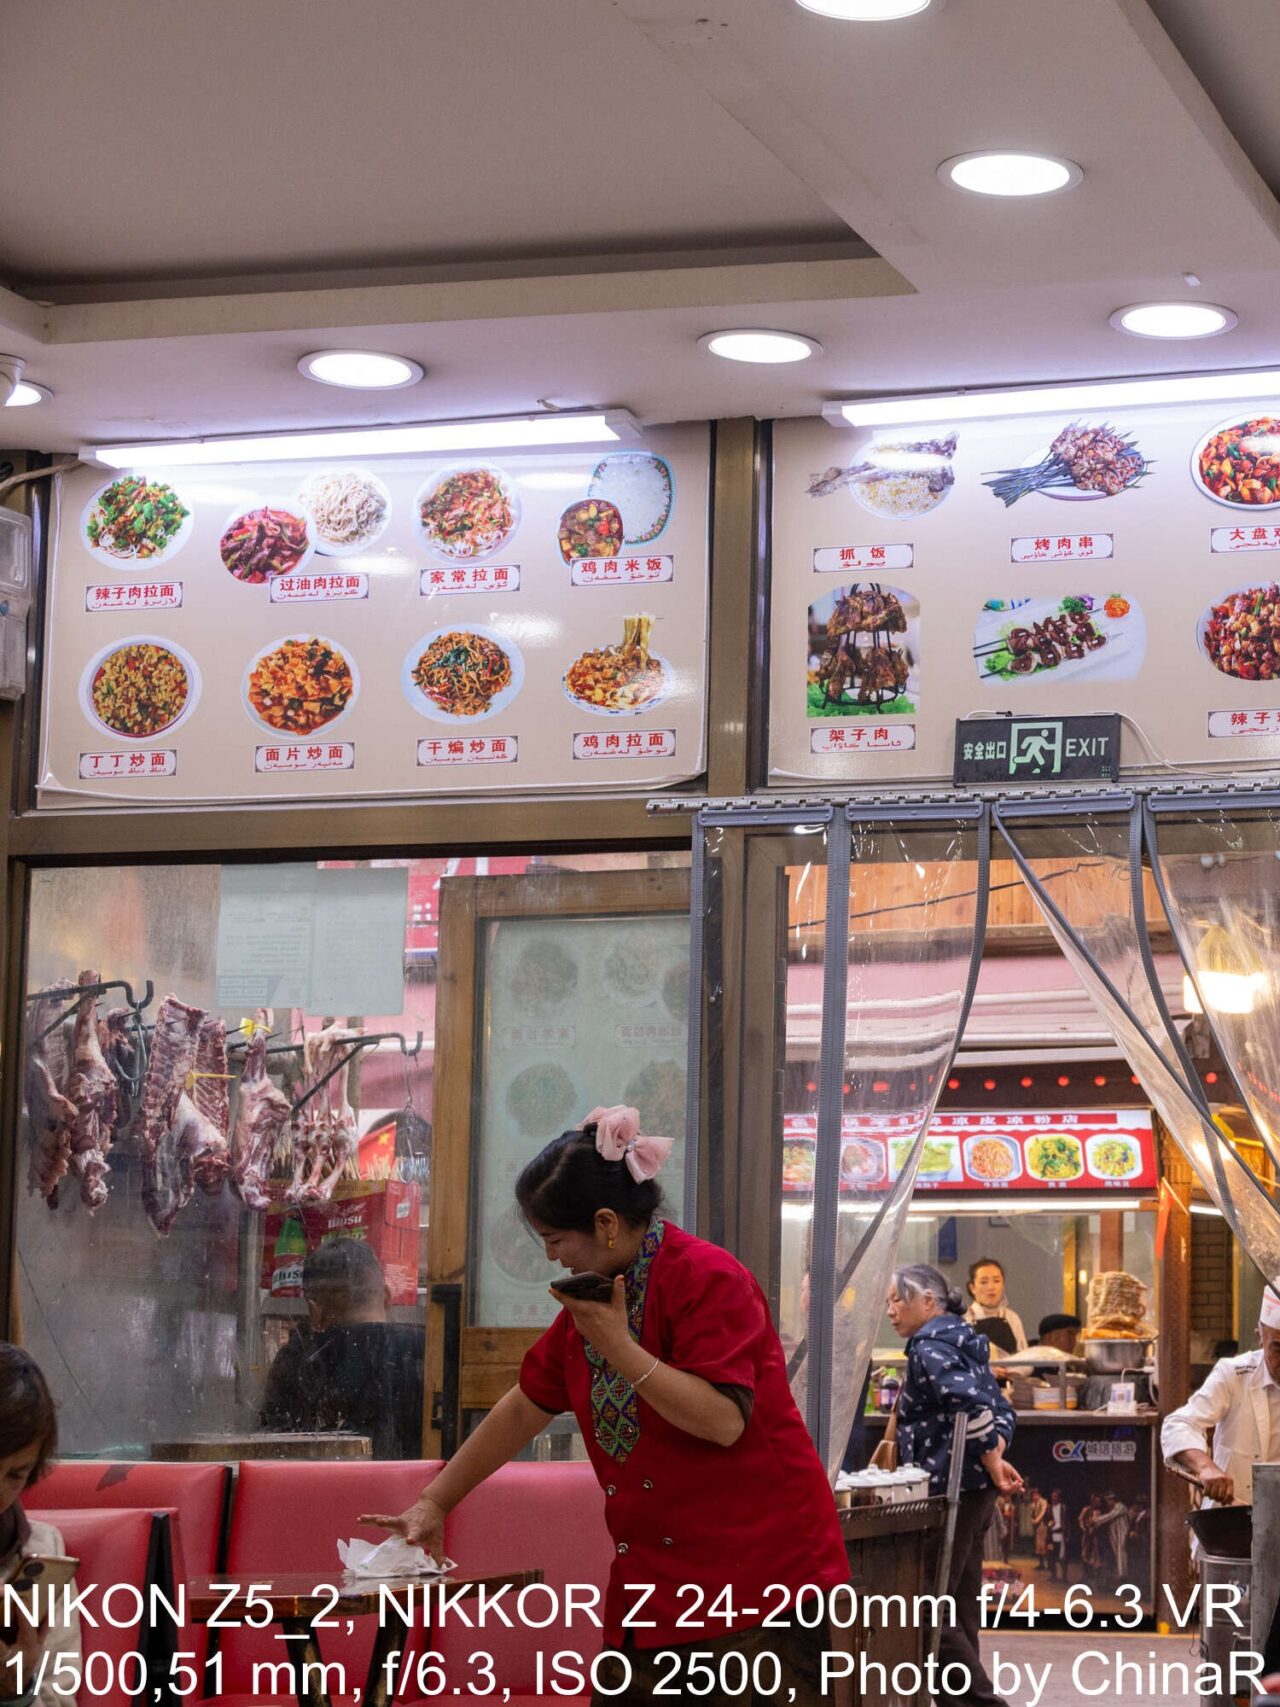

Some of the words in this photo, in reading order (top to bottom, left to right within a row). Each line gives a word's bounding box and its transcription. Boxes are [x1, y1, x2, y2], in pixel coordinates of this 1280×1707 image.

[1035, 536, 1093, 550] 烤肉串
[840, 547, 886, 560] 抓饭
[581, 556, 662, 573] 鸡肉米饭
[278, 574, 360, 591] 过油肉拉面
[430, 568, 508, 583] 家常拉面
[96, 584, 174, 600] 辣子肉拉面
[583, 732, 664, 748] 鸡肉拉面
[829, 727, 889, 742] 架子肉
[265, 745, 343, 761] 面片炒面
[428, 739, 506, 754] 干煸炒面
[963, 741, 1007, 760] 安全出口
[1065, 737, 1109, 757] EXIT
[90, 752, 165, 768] 丁丁炒面
